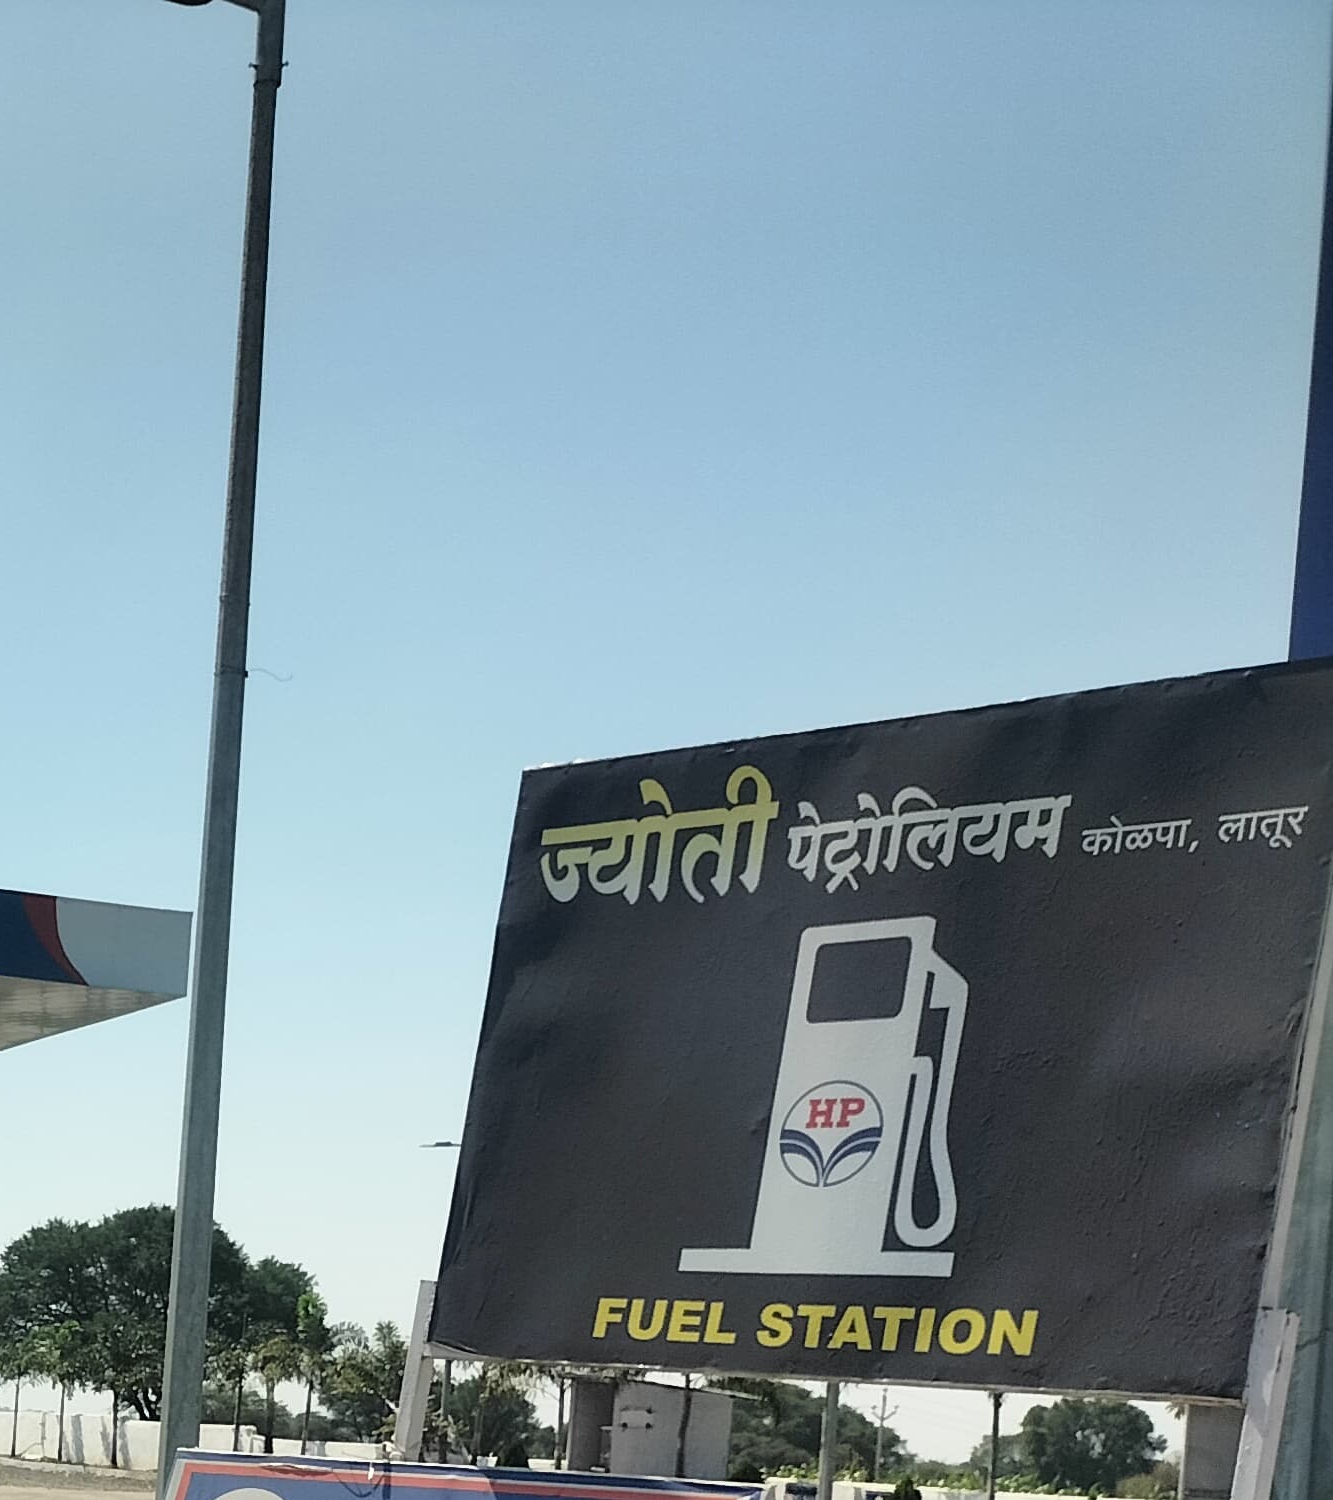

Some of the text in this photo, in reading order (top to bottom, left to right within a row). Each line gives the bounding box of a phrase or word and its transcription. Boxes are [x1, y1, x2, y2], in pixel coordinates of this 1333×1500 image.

[540, 764, 1309, 905] ज्योती पेट्रोलियम कोळपा, लातूर
[805, 1097, 866, 1129] HP
[592, 1297, 1039, 1357] FUEL STATION
